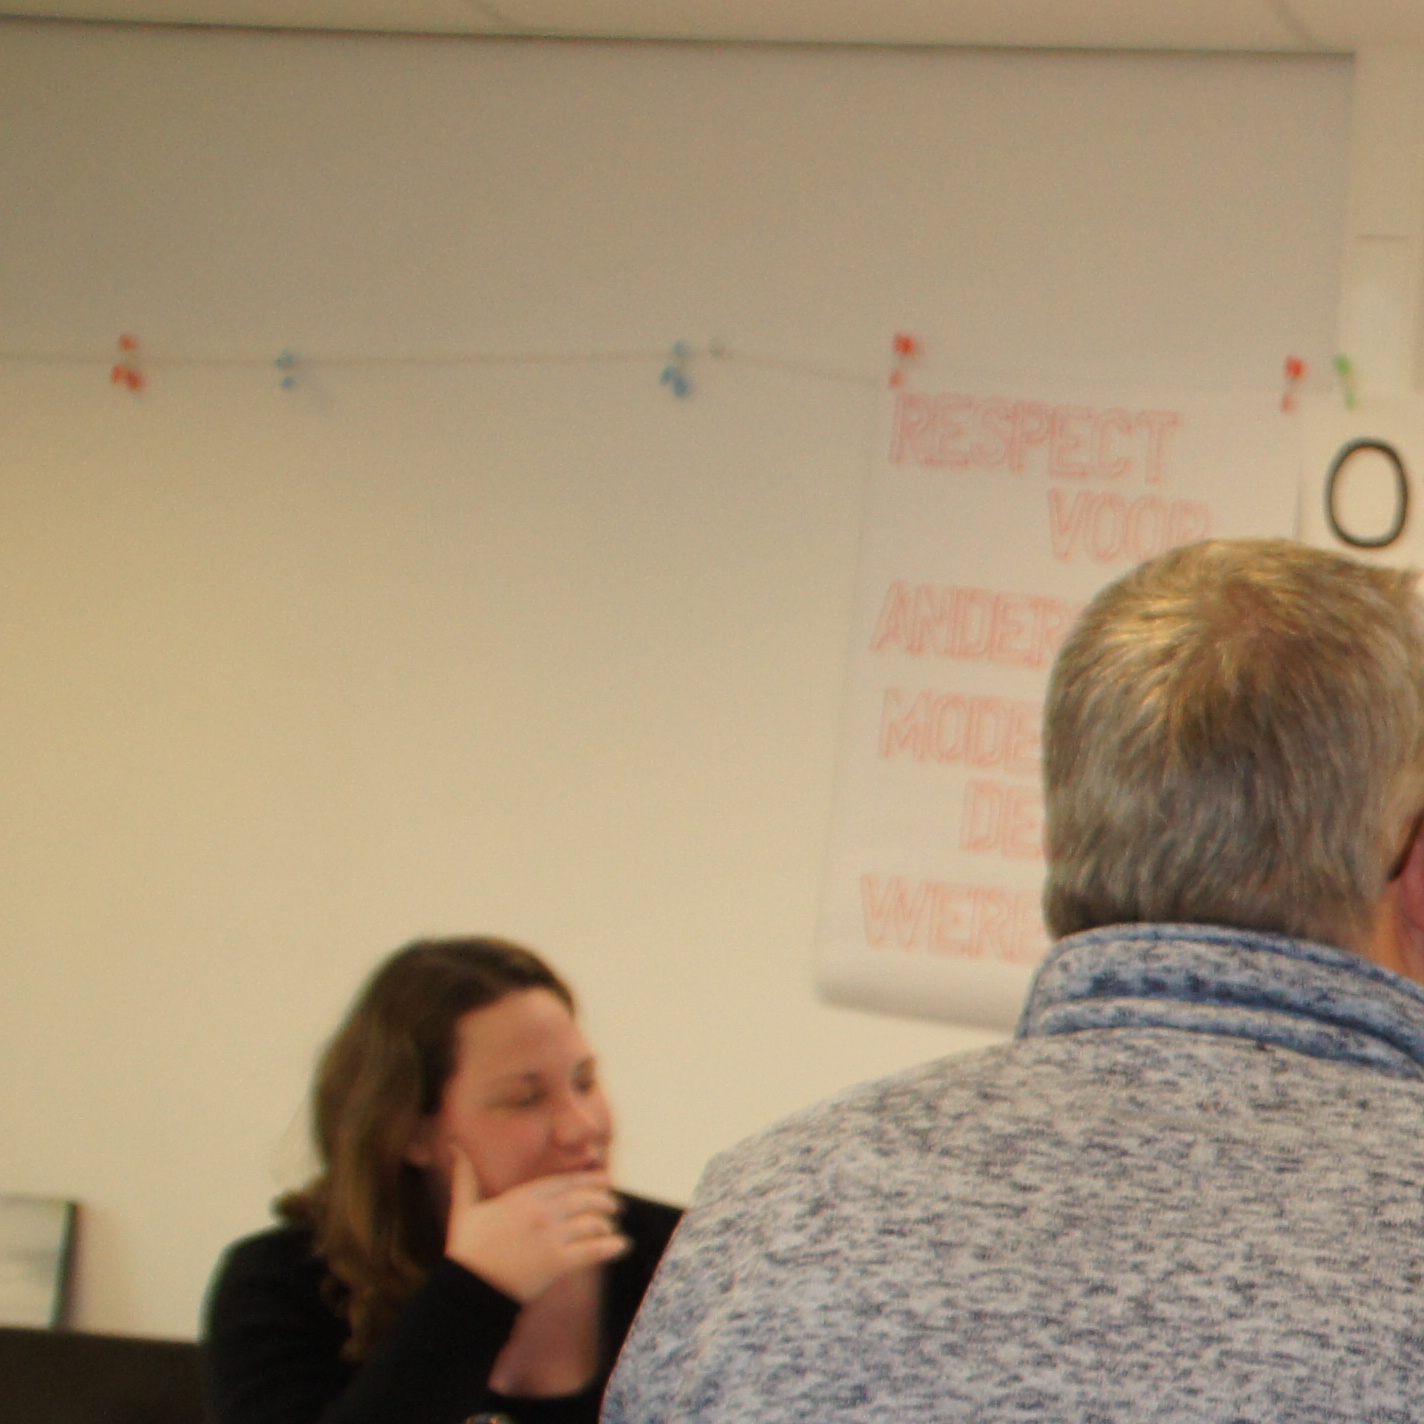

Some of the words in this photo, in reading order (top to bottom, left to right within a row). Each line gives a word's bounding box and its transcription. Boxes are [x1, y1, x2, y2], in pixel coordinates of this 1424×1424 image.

[888, 391, 1186, 485] RESPECT
[1324, 436, 1411, 550] O
[868, 579, 1090, 670] ANDER
[879, 686, 1044, 776] MODE
[860, 871, 1042, 967] WERE
